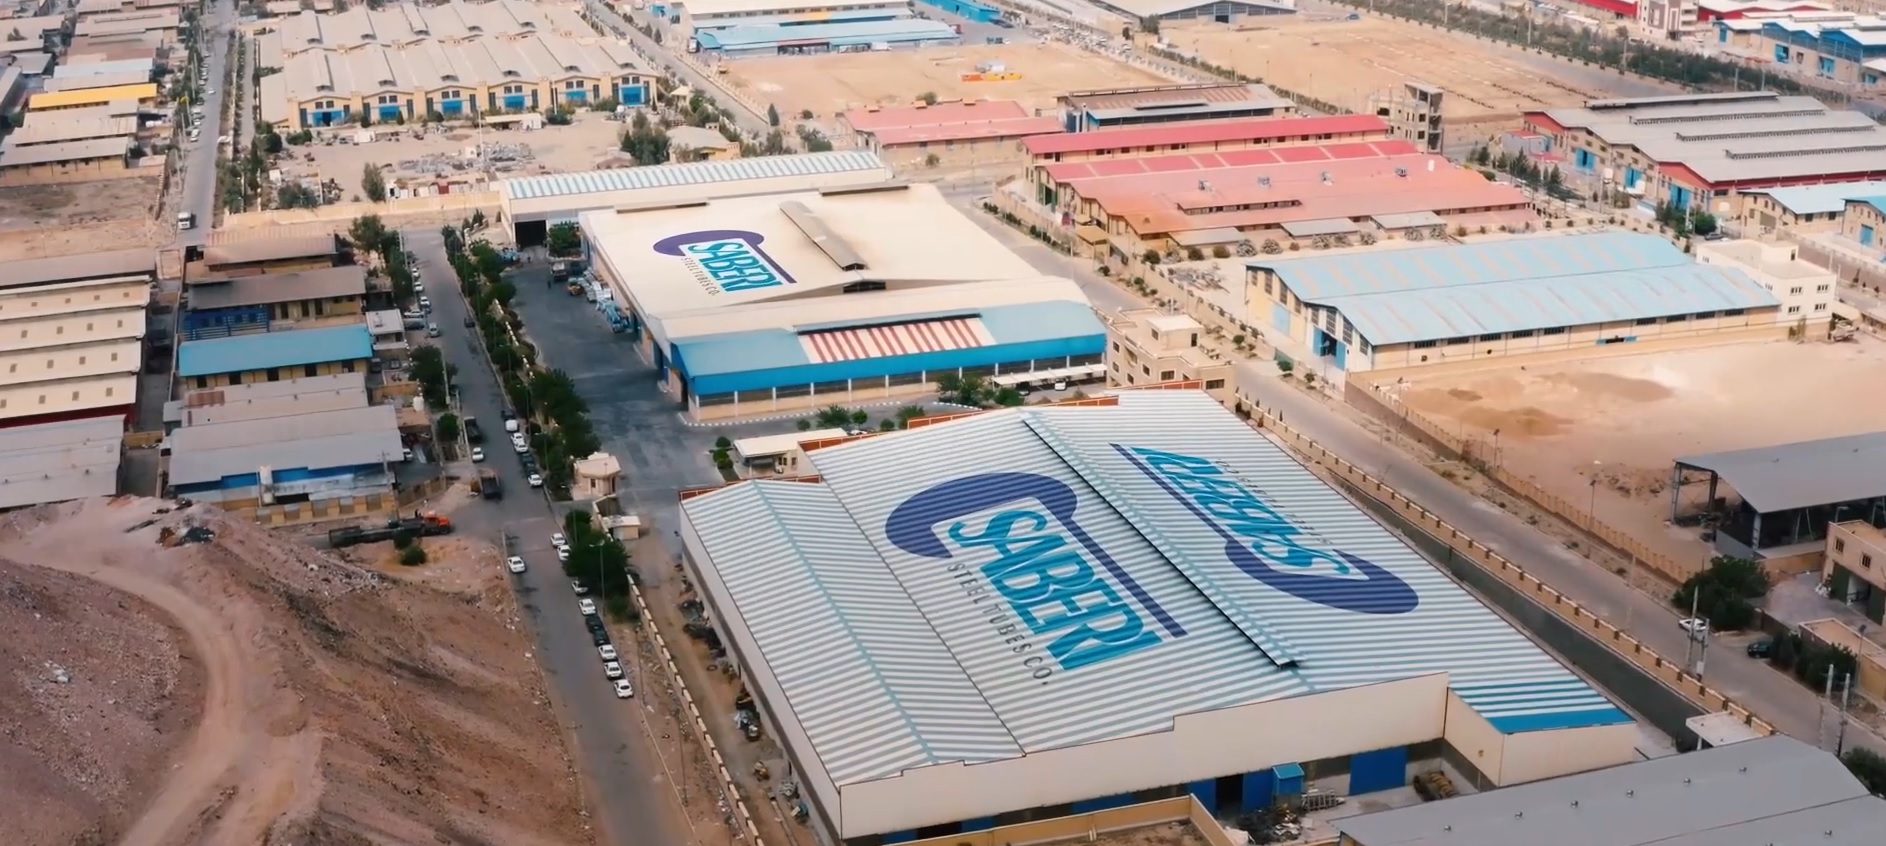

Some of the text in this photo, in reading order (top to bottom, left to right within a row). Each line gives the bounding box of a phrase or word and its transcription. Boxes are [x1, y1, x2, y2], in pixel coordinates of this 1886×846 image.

[688, 242, 783, 292] SABERI
[1130, 446, 1351, 575] SABERI
[947, 510, 1163, 670] SABERI
[947, 563, 1053, 685] STEEL TUBES CO.
